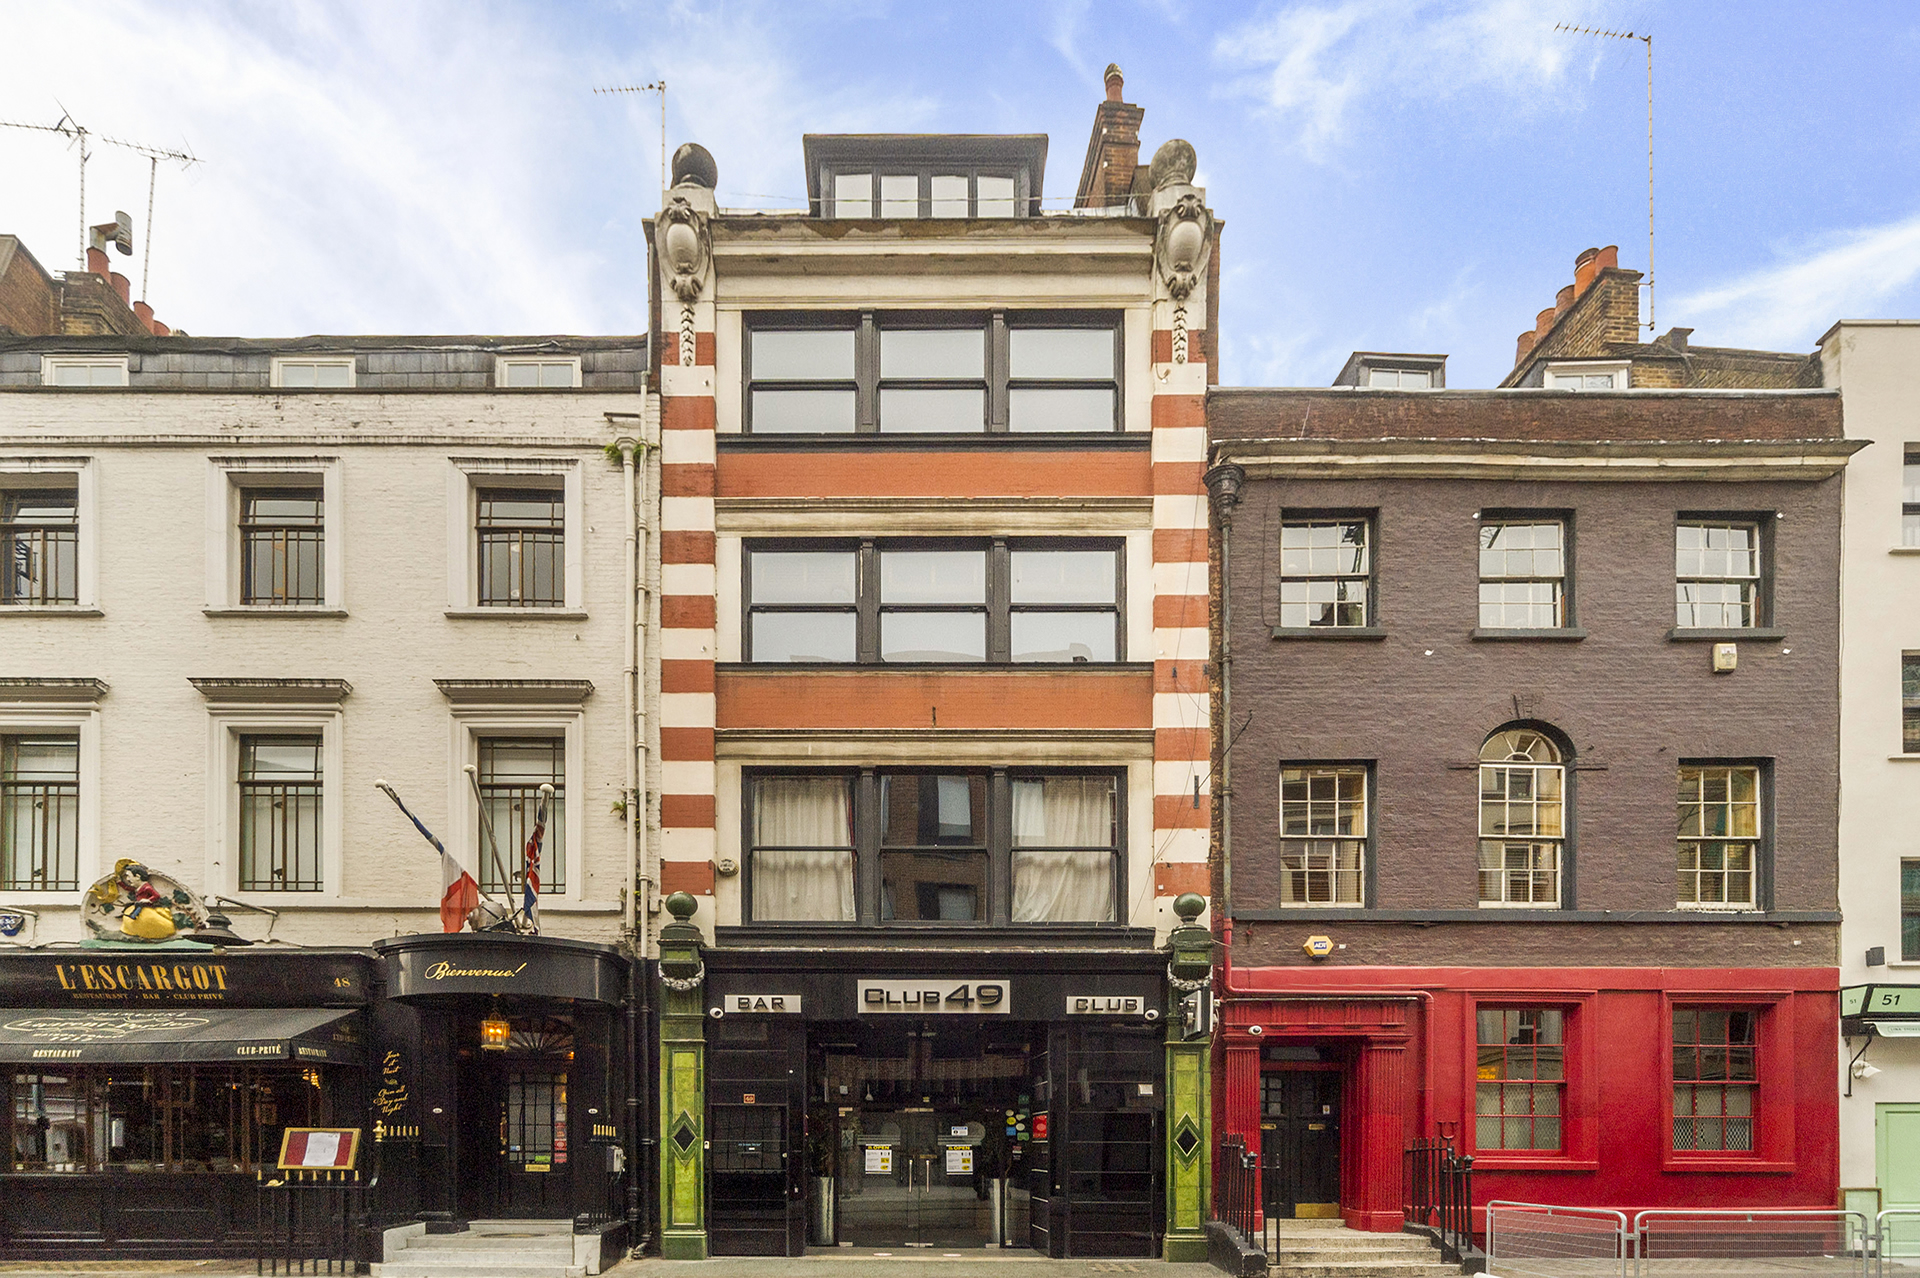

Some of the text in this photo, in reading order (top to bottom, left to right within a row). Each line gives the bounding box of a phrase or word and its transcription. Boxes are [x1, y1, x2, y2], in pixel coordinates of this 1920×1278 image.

[425, 960, 527, 980] Bienvenue!
[55, 965, 227, 990] L'ESCARGOT
[334, 977, 351, 988] 48
[738, 996, 785, 1010] BAR
[1075, 998, 1138, 1011] CLUB
[1882, 994, 1900, 1005] 51
[33, 1050, 82, 1058] RESTAURANT
[237, 1043, 282, 1055] CLUB-PRIVÉ
